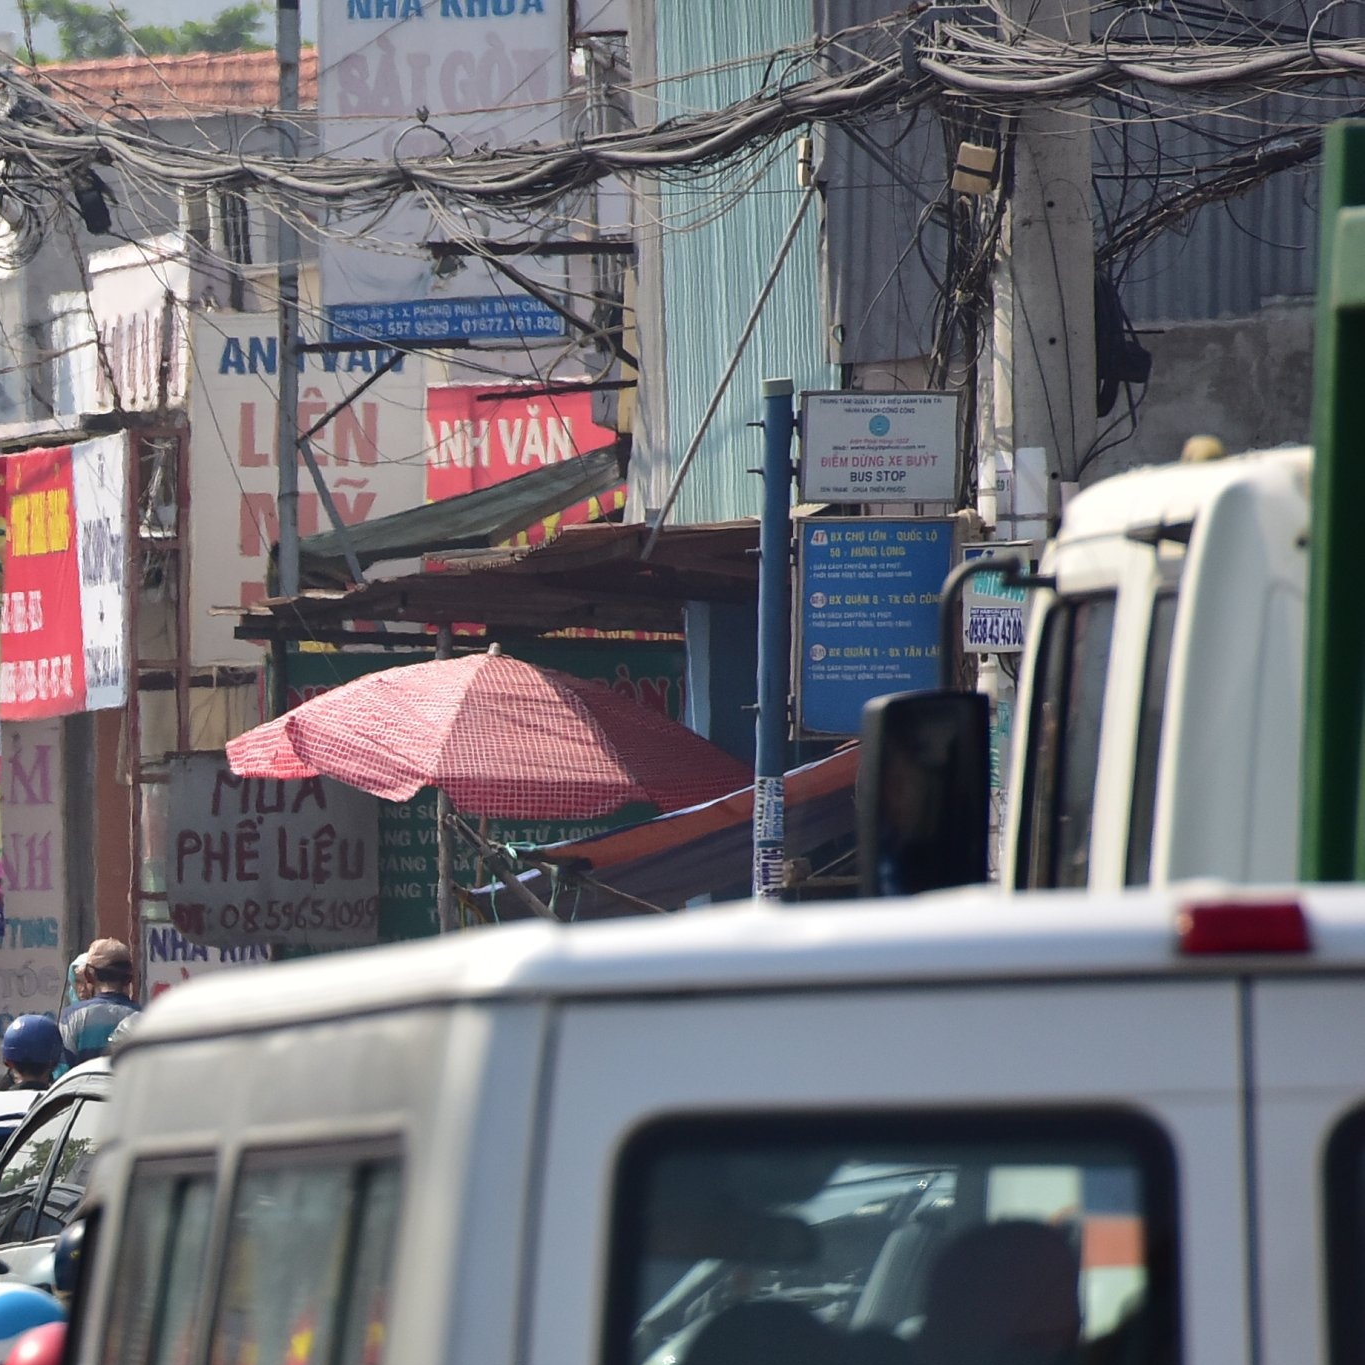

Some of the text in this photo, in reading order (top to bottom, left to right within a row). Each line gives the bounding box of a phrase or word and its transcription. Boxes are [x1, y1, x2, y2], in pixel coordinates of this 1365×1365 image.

[499, 404, 572, 465] VĂN
[851, 453, 884, 467] DỪNG
[889, 455, 902, 466] XE
[850, 470, 907, 482] BUS STOP
[813, 532, 826, 543] 47
[211, 769, 327, 816] MUA
